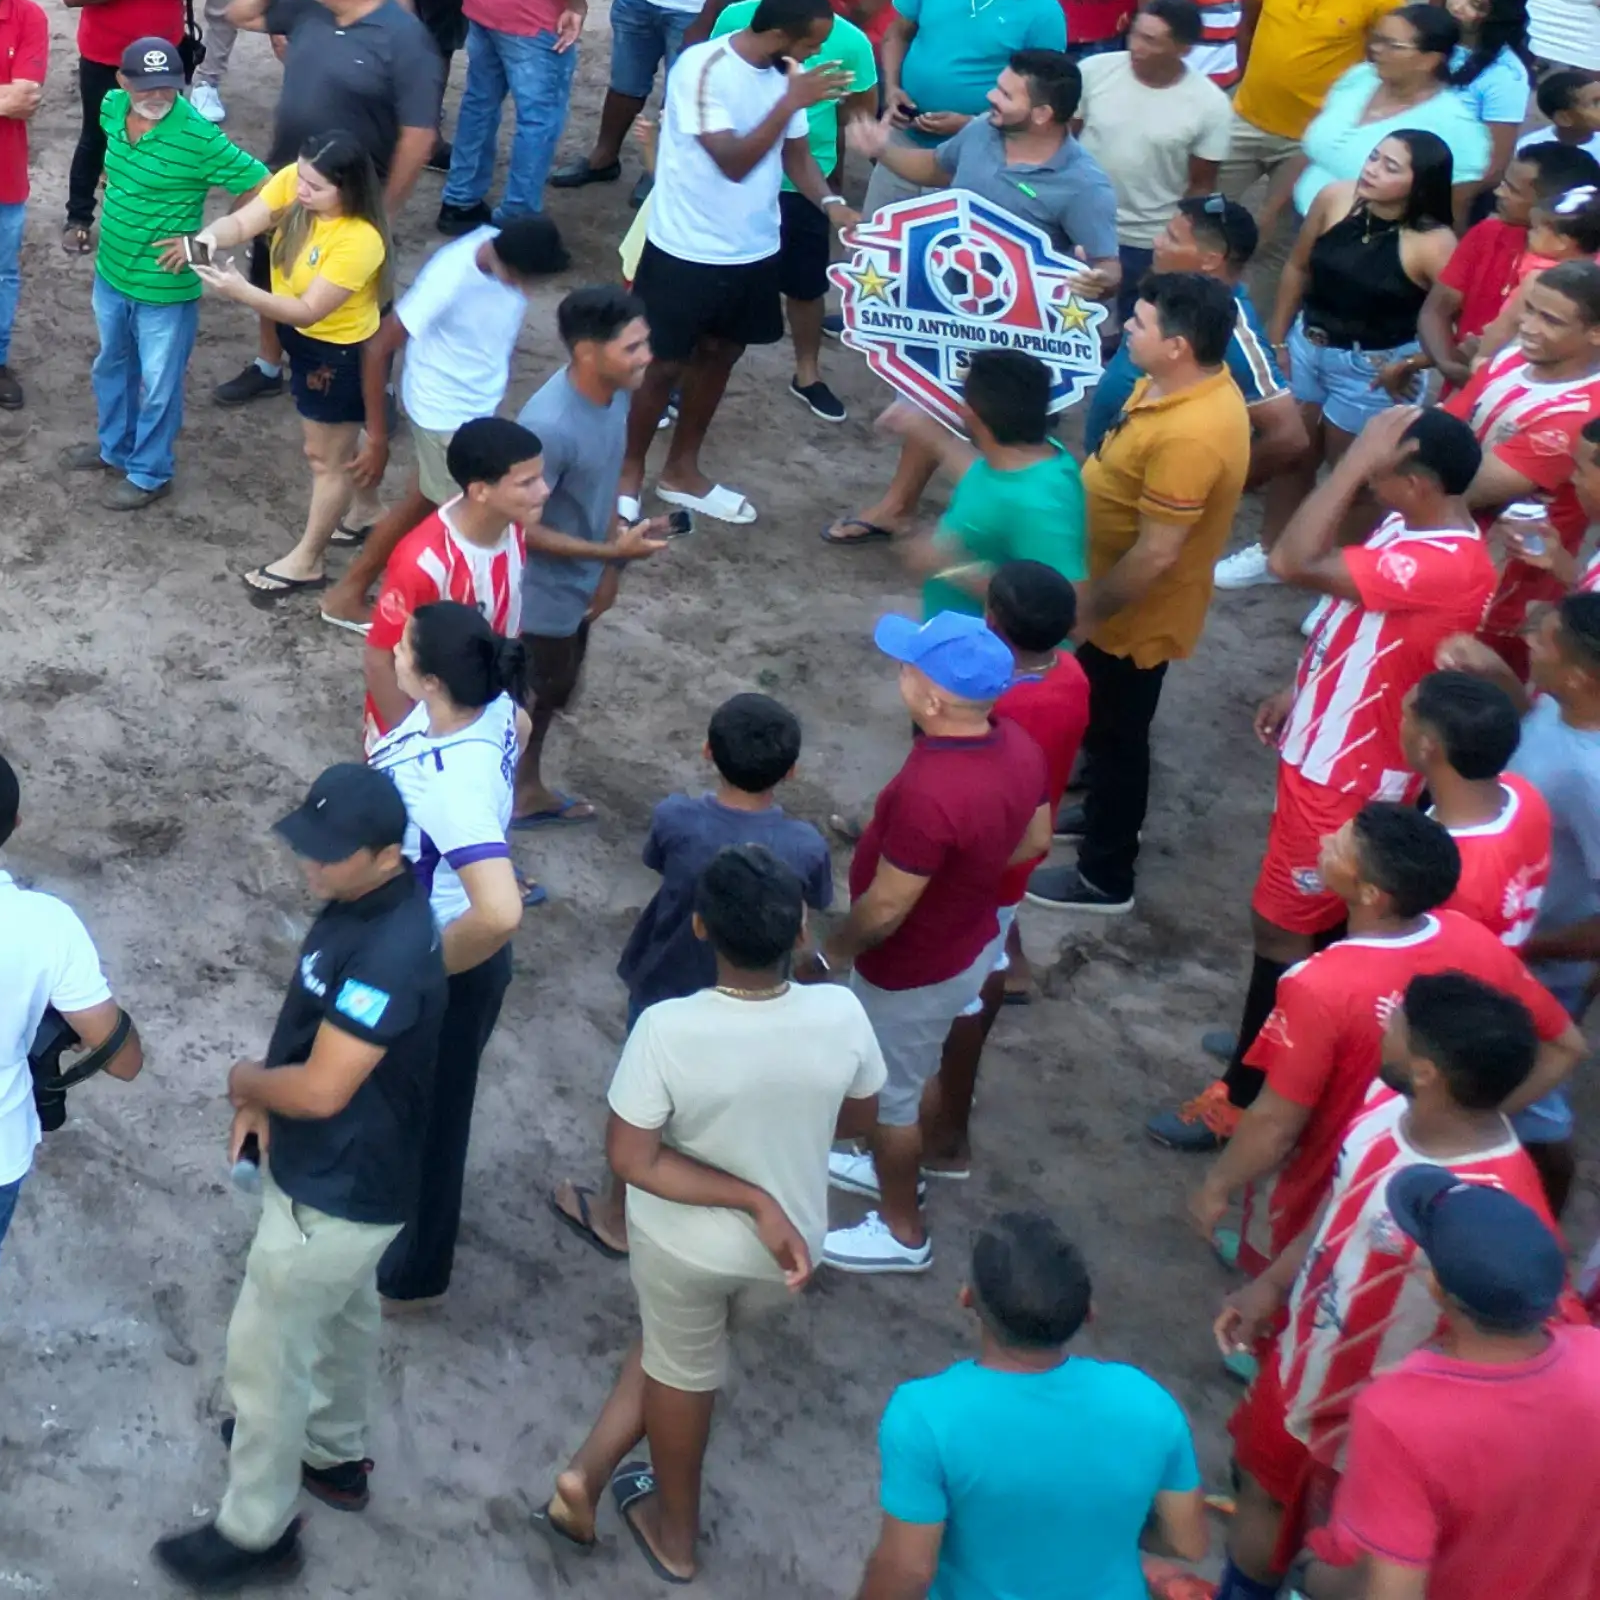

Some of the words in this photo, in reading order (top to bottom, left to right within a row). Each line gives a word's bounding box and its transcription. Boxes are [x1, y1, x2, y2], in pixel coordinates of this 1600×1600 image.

[861, 308, 913, 332] SANTO
[917, 317, 987, 342] ANTÔNIO
[990, 328, 1009, 346] DO
[1013, 332, 1072, 357] APRÍGIO
[1074, 343, 1092, 360] FC
